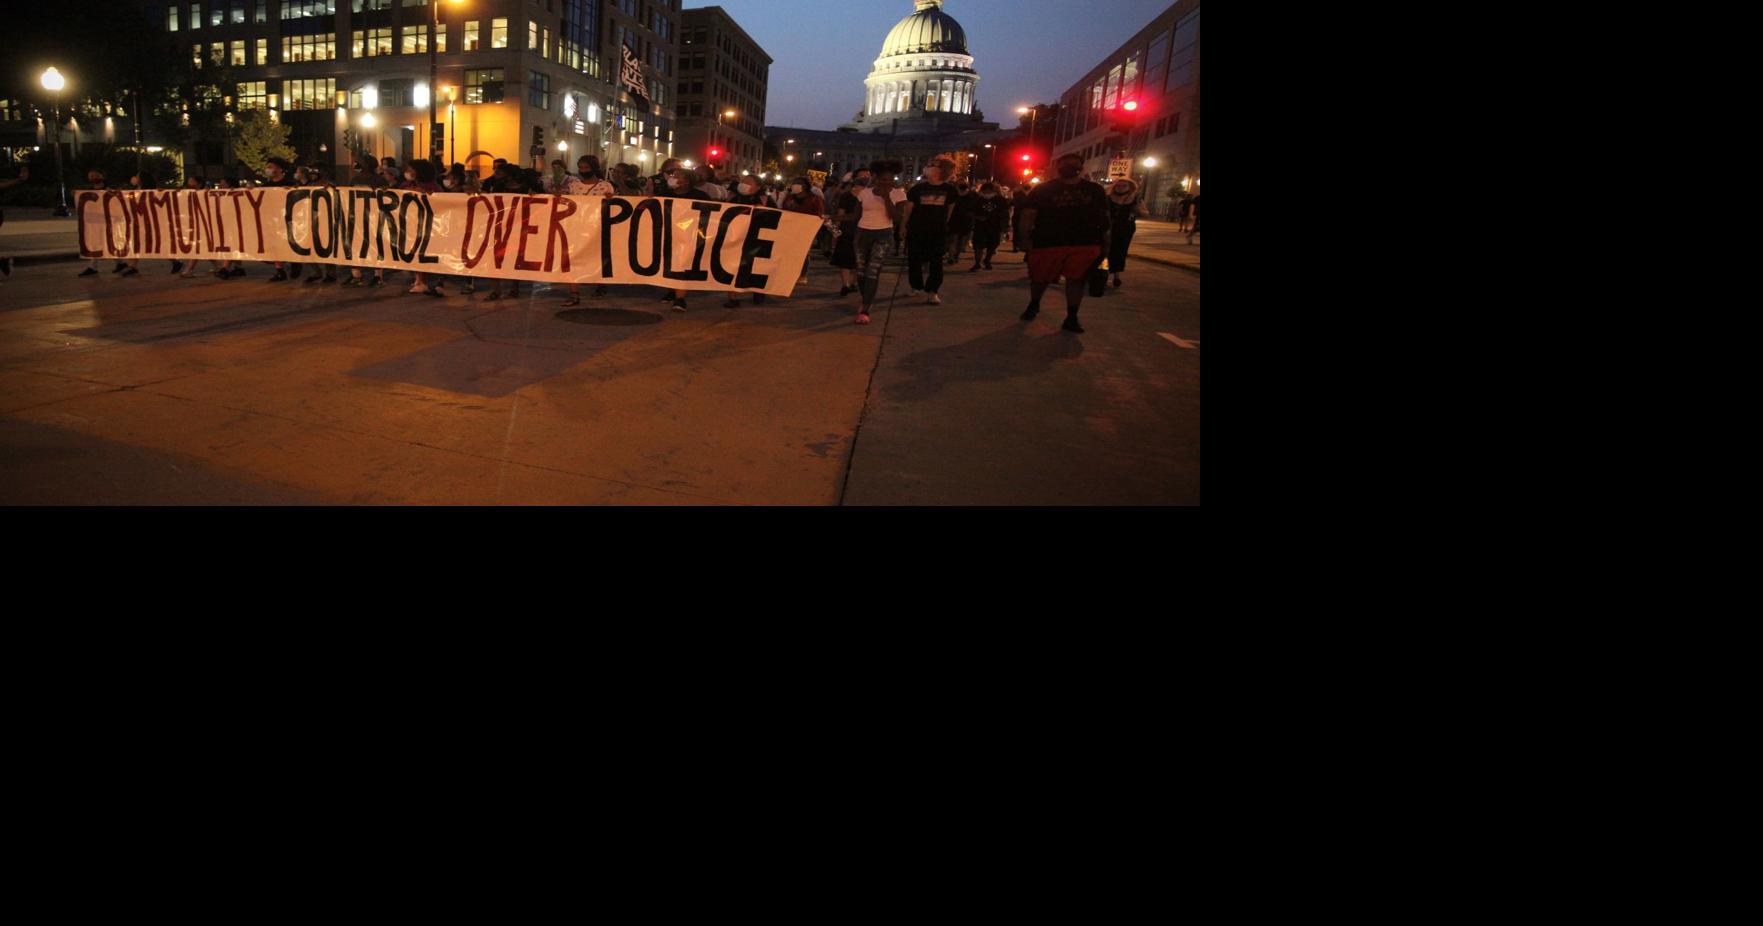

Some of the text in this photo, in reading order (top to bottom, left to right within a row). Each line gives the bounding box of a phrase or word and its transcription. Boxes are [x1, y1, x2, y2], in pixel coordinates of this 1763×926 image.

[78, 189, 782, 289] COMMUNITY CONTROL OVER POLICE
